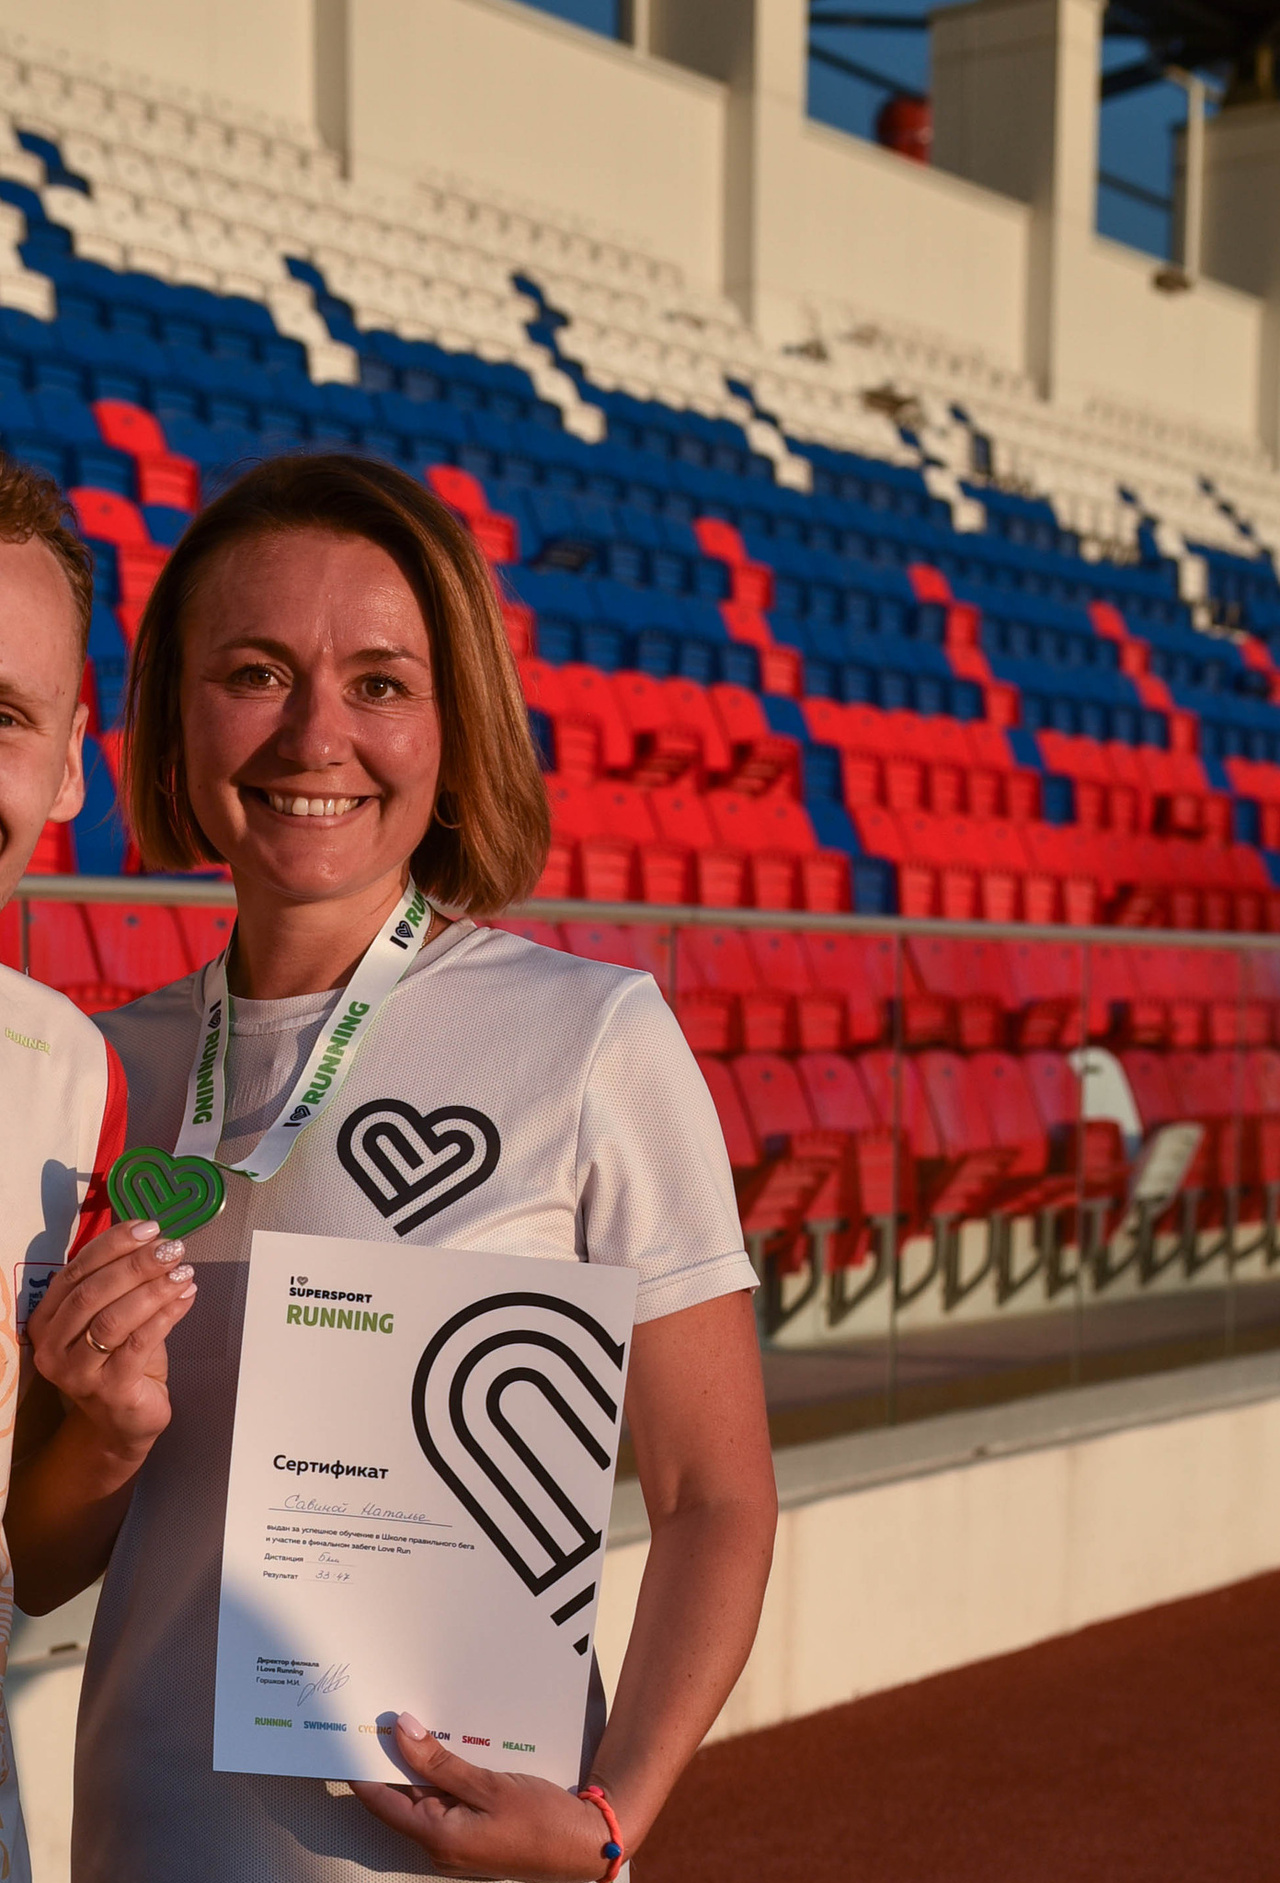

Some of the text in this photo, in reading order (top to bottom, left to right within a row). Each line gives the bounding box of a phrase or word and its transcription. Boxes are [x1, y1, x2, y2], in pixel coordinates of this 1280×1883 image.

[301, 1001, 370, 1105] RUNNING
[192, 1028, 220, 1125] RUNNING
[289, 1287, 373, 1304] SUPERSPORT
[286, 1304, 394, 1334] RUNNING
[273, 1454, 389, 1479] Сертификат
[284, 1494, 348, 1513] Савиной
[266, 1524, 290, 1533] выдан
[301, 1527, 338, 1536] успешное
[339, 1529, 374, 1539] обучение
[381, 1533, 407, 1543] Школе
[408, 1537, 457, 1548] правильного
[458, 1541, 475, 1550] бега
[272, 1537, 301, 1545] участие
[308, 1539, 350, 1549] финальном
[351, 1543, 376, 1551] забеге
[377, 1545, 395, 1553] Love
[396, 1547, 411, 1555] Run
[264, 1553, 304, 1562] Дистанция
[263, 1570, 298, 1580] Результат
[256, 1656, 319, 1667] Директор филиала
[277, 1667, 304, 1676] Running
[254, 1717, 292, 1728] RUNNING
[303, 1721, 347, 1732] SWIMMING
[358, 1724, 392, 1735] CYCLING
[462, 1735, 491, 1746] SKIING
[502, 1741, 535, 1753] HEALTH
